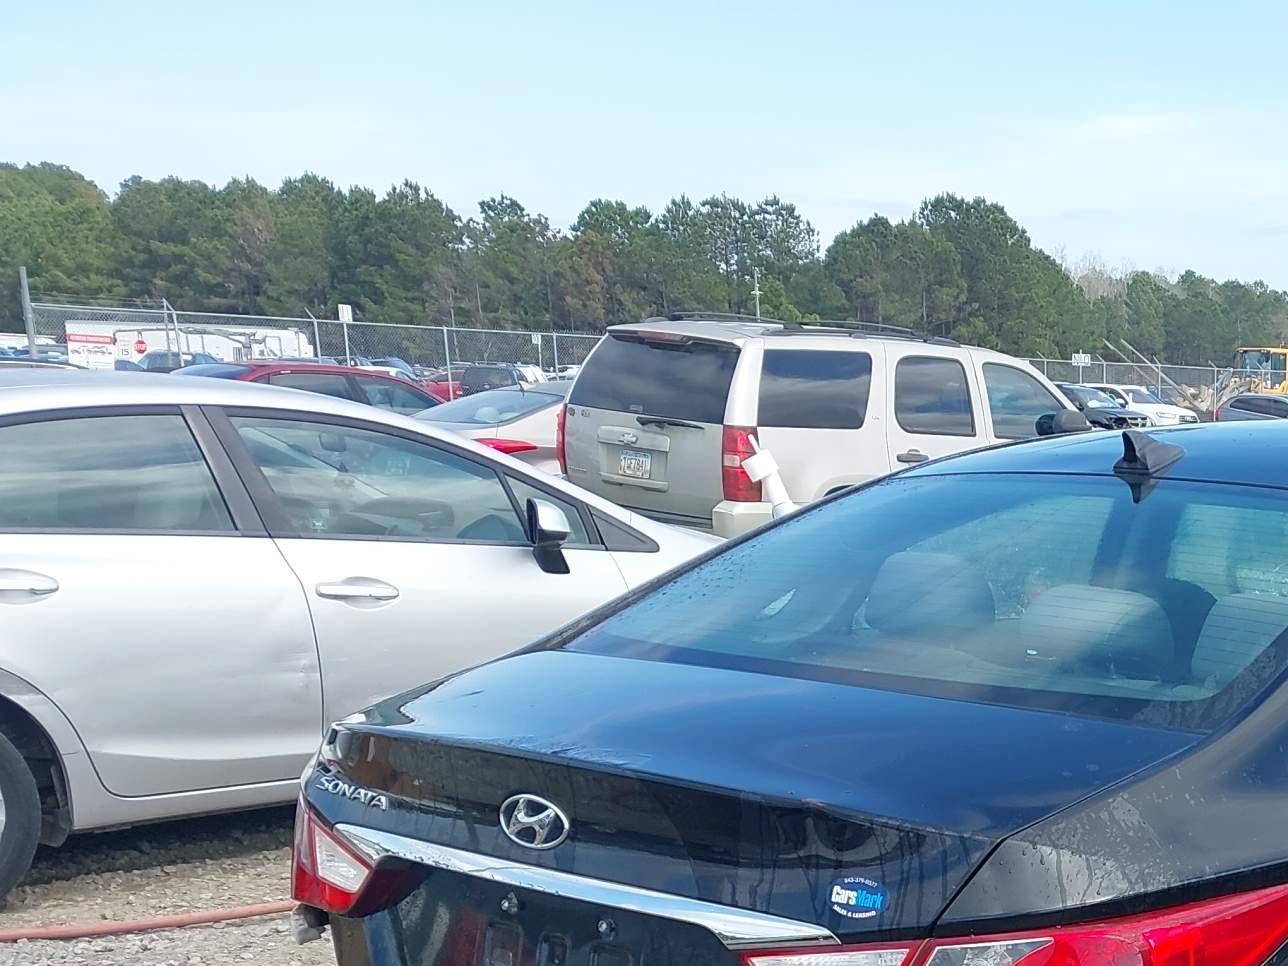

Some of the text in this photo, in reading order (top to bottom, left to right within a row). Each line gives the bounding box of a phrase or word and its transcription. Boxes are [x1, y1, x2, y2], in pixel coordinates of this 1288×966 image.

[315, 776, 387, 811] SONATA
[832, 904, 847, 916] SALES
[853, 910, 877, 918] LEASING
